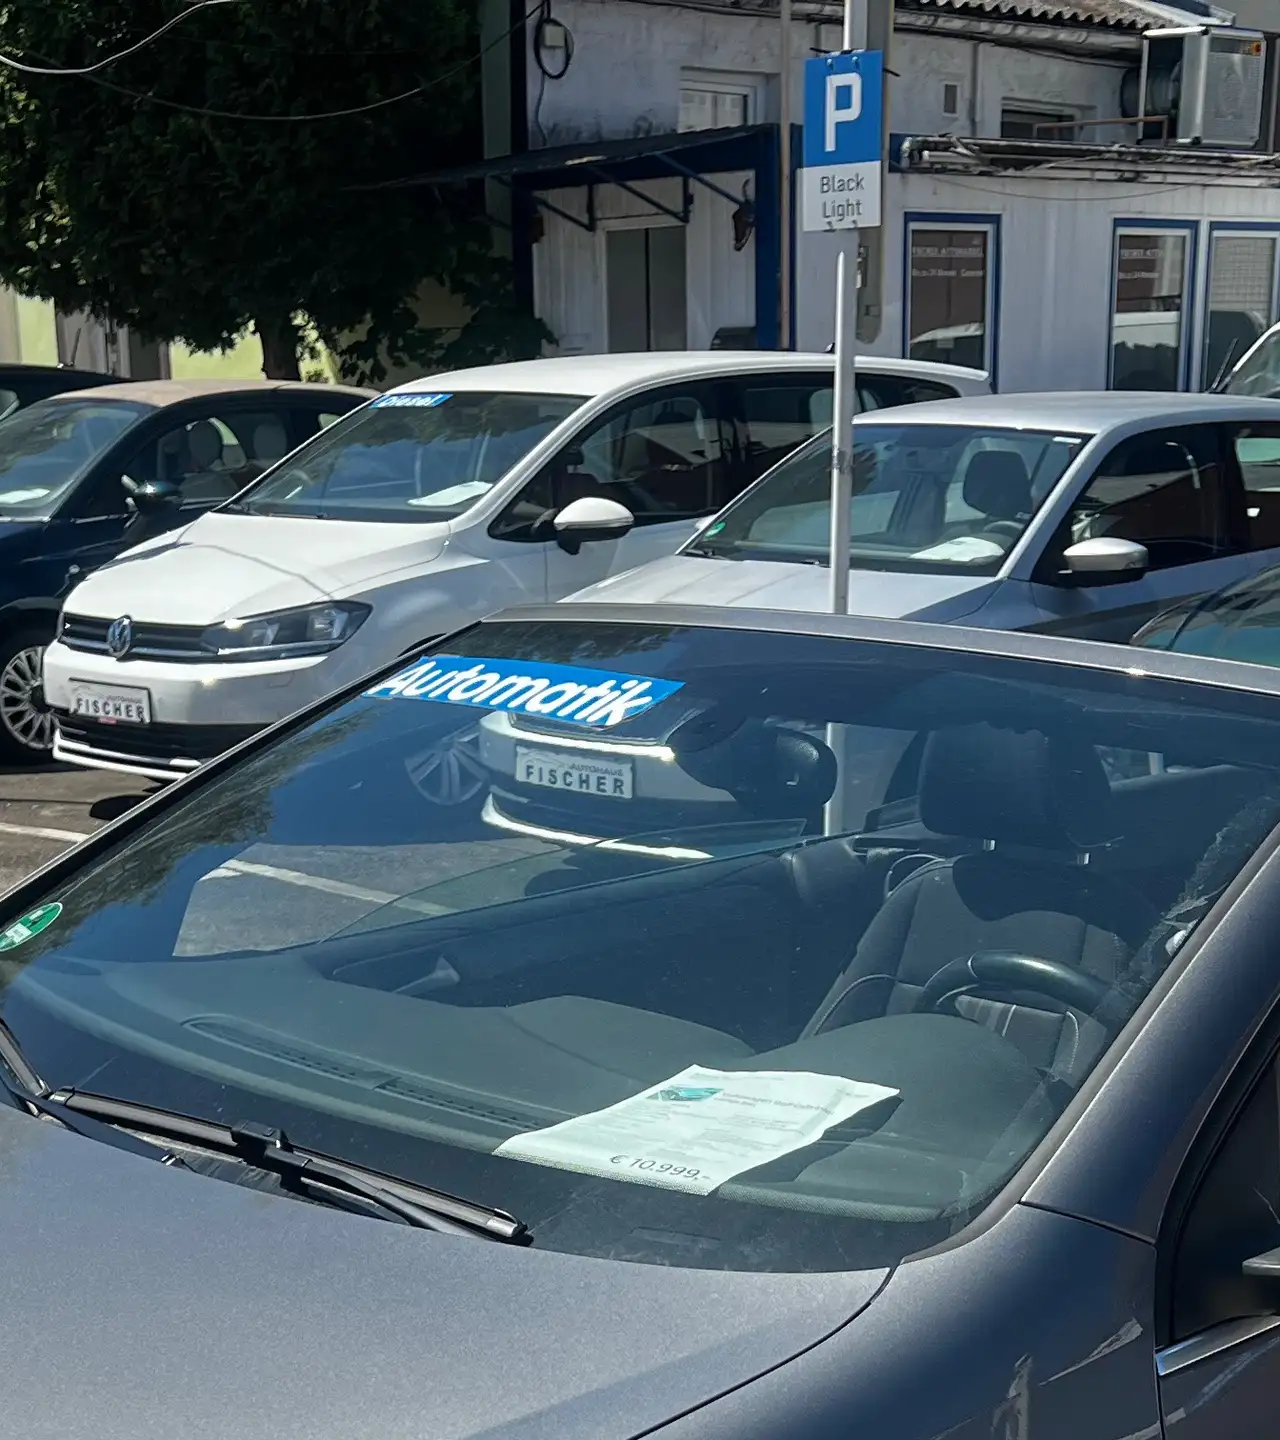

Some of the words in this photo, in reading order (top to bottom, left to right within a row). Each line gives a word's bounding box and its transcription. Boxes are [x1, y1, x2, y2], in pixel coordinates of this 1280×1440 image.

[824, 72, 863, 152] P
[820, 172, 865, 194] Black
[822, 198, 863, 222] Light
[376, 394, 444, 408] Diesel
[366, 660, 654, 727] Automatik
[76, 697, 145, 720] FISCHER
[525, 764, 625, 795] FISCHER
[610, 1154, 629, 1164] €
[629, 1157, 712, 1181] 10.999,-
